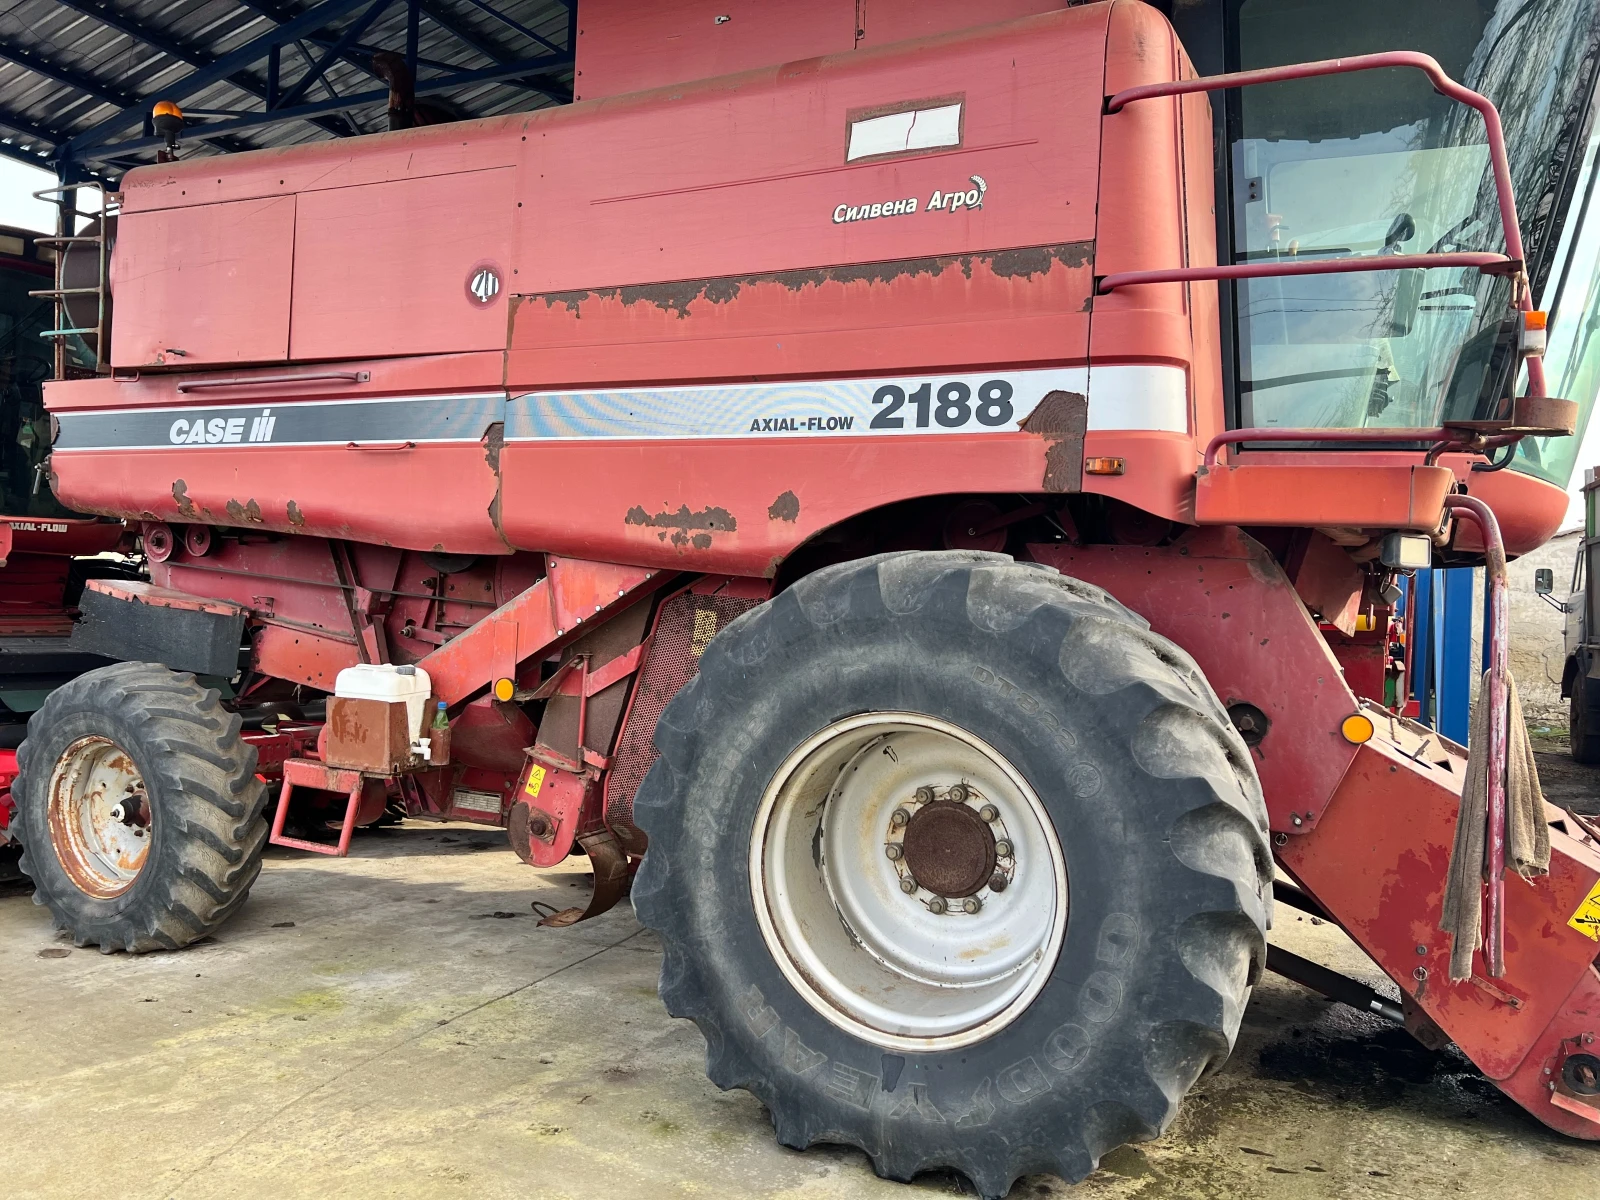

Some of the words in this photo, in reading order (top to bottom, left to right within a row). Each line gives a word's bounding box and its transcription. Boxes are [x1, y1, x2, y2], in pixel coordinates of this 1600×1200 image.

[832, 197, 918, 224] Силвена
[925, 189, 979, 213] Агро
[750, 416, 854, 432] AXIAL-FLOW
[869, 379, 1014, 429] 2188
[169, 417, 246, 444] CASE
[971, 665, 1077, 752] DT822
